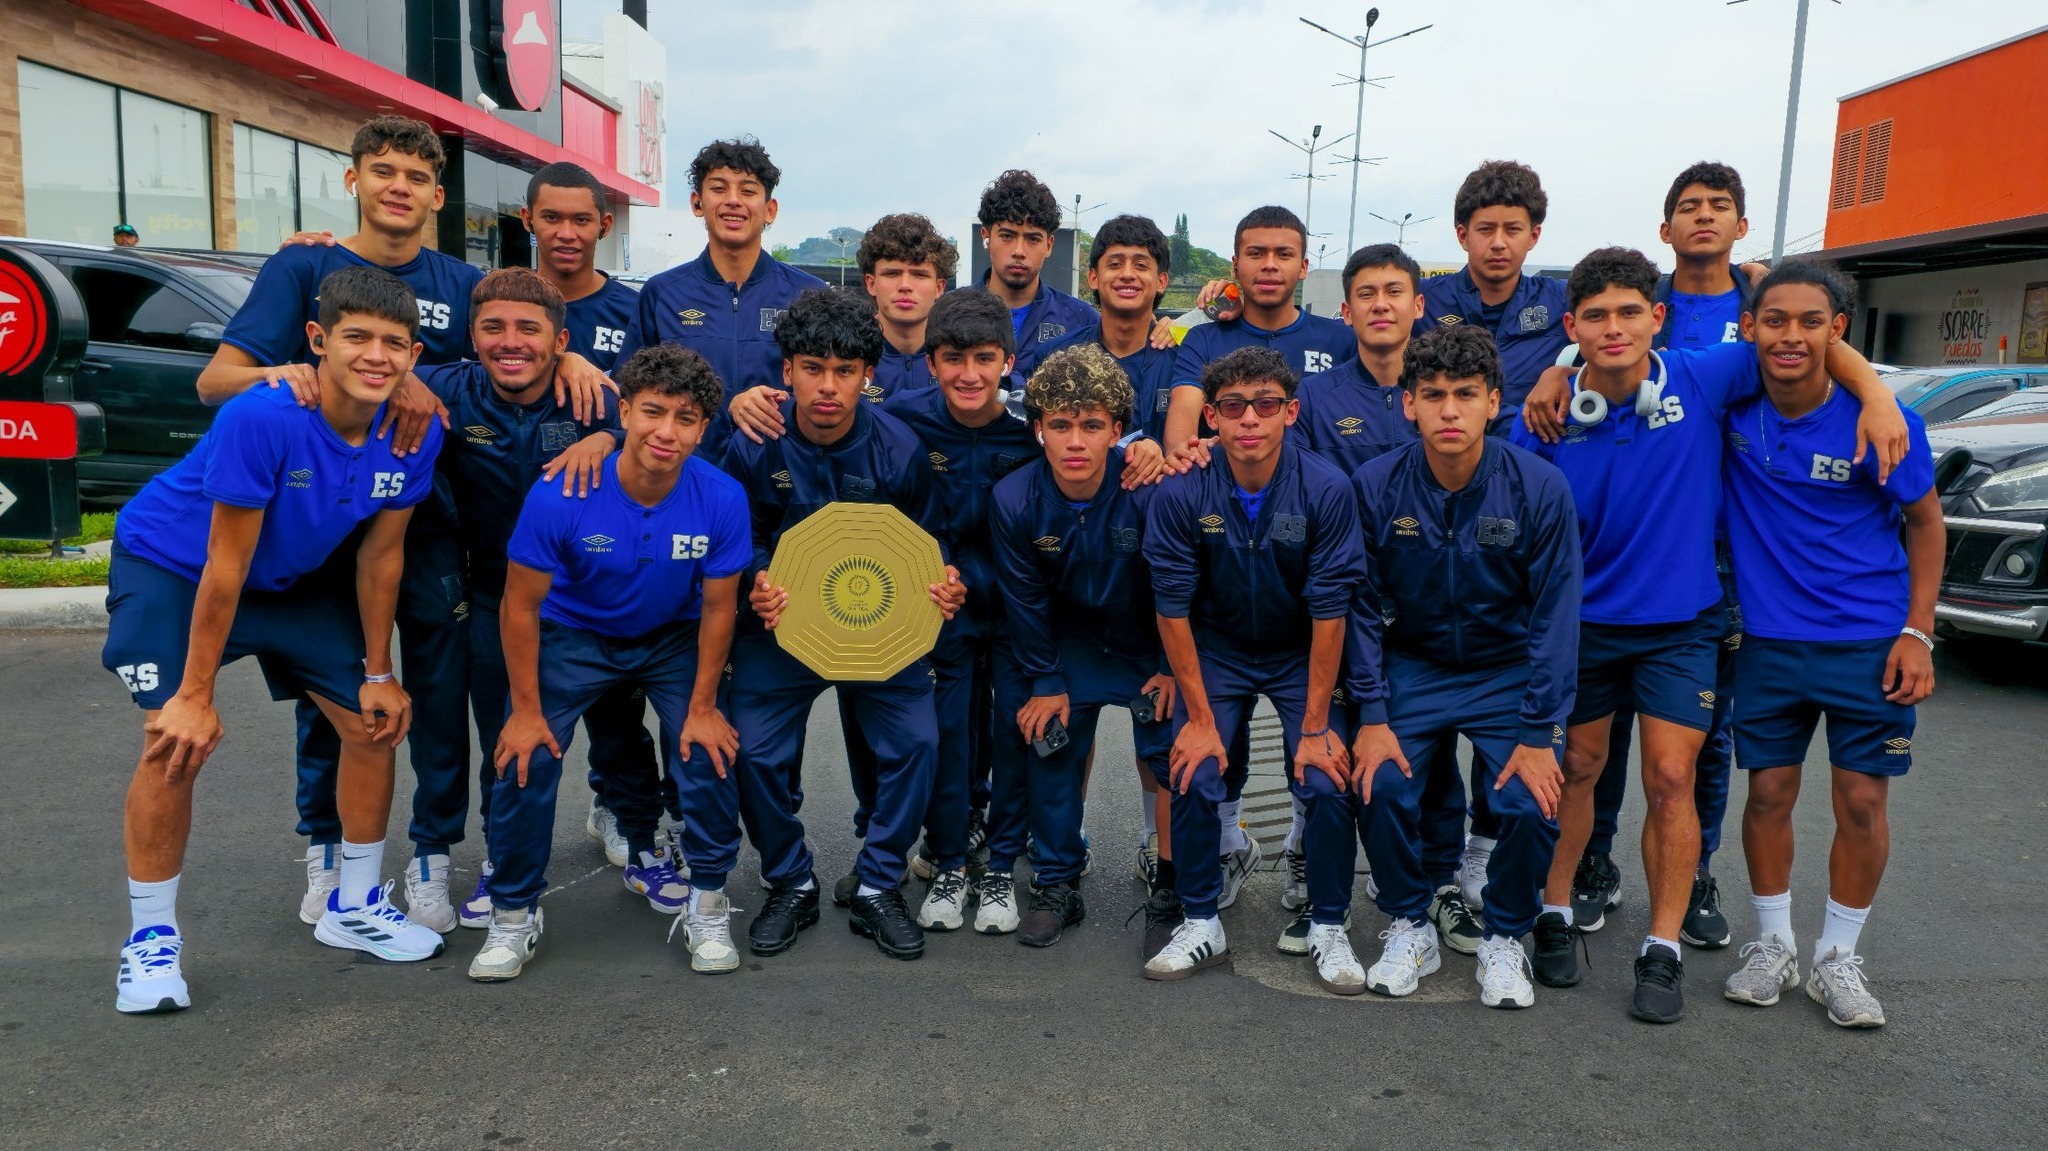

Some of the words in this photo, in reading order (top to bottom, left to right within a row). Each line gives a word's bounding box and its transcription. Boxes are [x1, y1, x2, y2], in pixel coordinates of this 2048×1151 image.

[415, 299, 450, 330] ES
[682, 318, 703, 326] umbro
[1519, 305, 1549, 333] ES
[1944, 310, 1984, 341] SOBRE
[593, 326, 626, 354] ES
[1721, 321, 1739, 344] E
[1943, 332, 1983, 360] ruedas
[1303, 350, 1333, 374] ES
[466, 436, 492, 446] umbro
[1810, 453, 1851, 482] ES
[370, 472, 405, 498] ES
[1270, 512, 1307, 543] ES
[1395, 529, 1419, 538] umbro
[1477, 516, 1515, 547] ES
[672, 534, 709, 560] ES
[116, 663, 158, 693] ES
